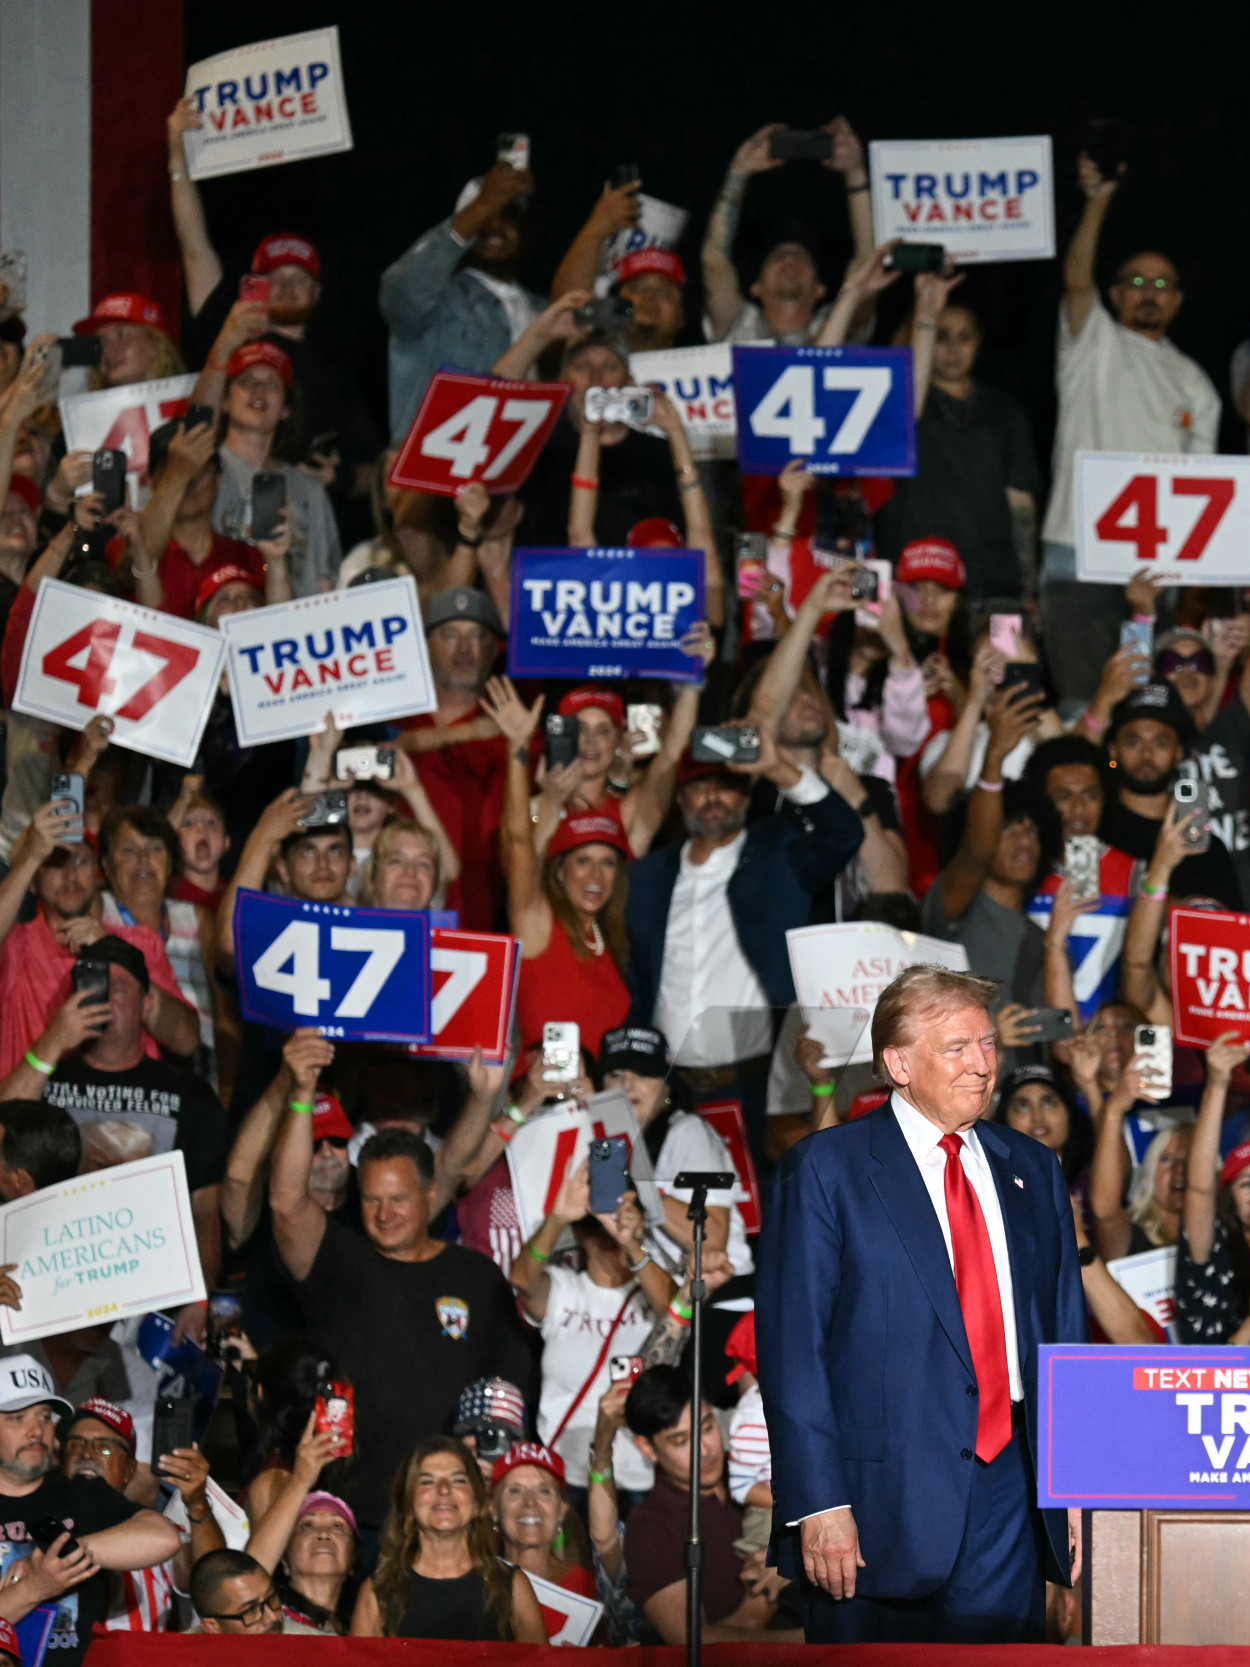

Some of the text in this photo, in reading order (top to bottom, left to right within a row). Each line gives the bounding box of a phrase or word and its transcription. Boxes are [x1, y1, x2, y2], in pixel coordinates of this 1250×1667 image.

[194, 61, 330, 112] TRUMP
[209, 92, 318, 131] VANCE
[884, 169, 1040, 200] TRUMP
[903, 197, 1022, 222] VANCE
[750, 366, 892, 455] 47
[420, 395, 553, 480] 47
[1096, 475, 1236, 561] 47
[522, 579, 695, 615] TRUMP
[541, 611, 676, 640] VANCE
[239, 615, 409, 675] TRUMP
[42, 618, 201, 721] 47
[264, 649, 396, 695] VANCE
[252, 920, 405, 1018] 47
[431, 948, 488, 1035] 7
[318, 1026, 345, 1038] 024
[85, 1084, 145, 1100] VOTING
[150, 1089, 181, 1106] FOR
[43, 1208, 134, 1246] LATINO
[20, 1227, 167, 1280] AMERICANS
[53, 1259, 140, 1296] for TRUMP
[9, 1369, 52, 1394] USA
[1144, 1369, 1206, 1389] TEXT
[1189, 1472, 1228, 1483] MAKE
